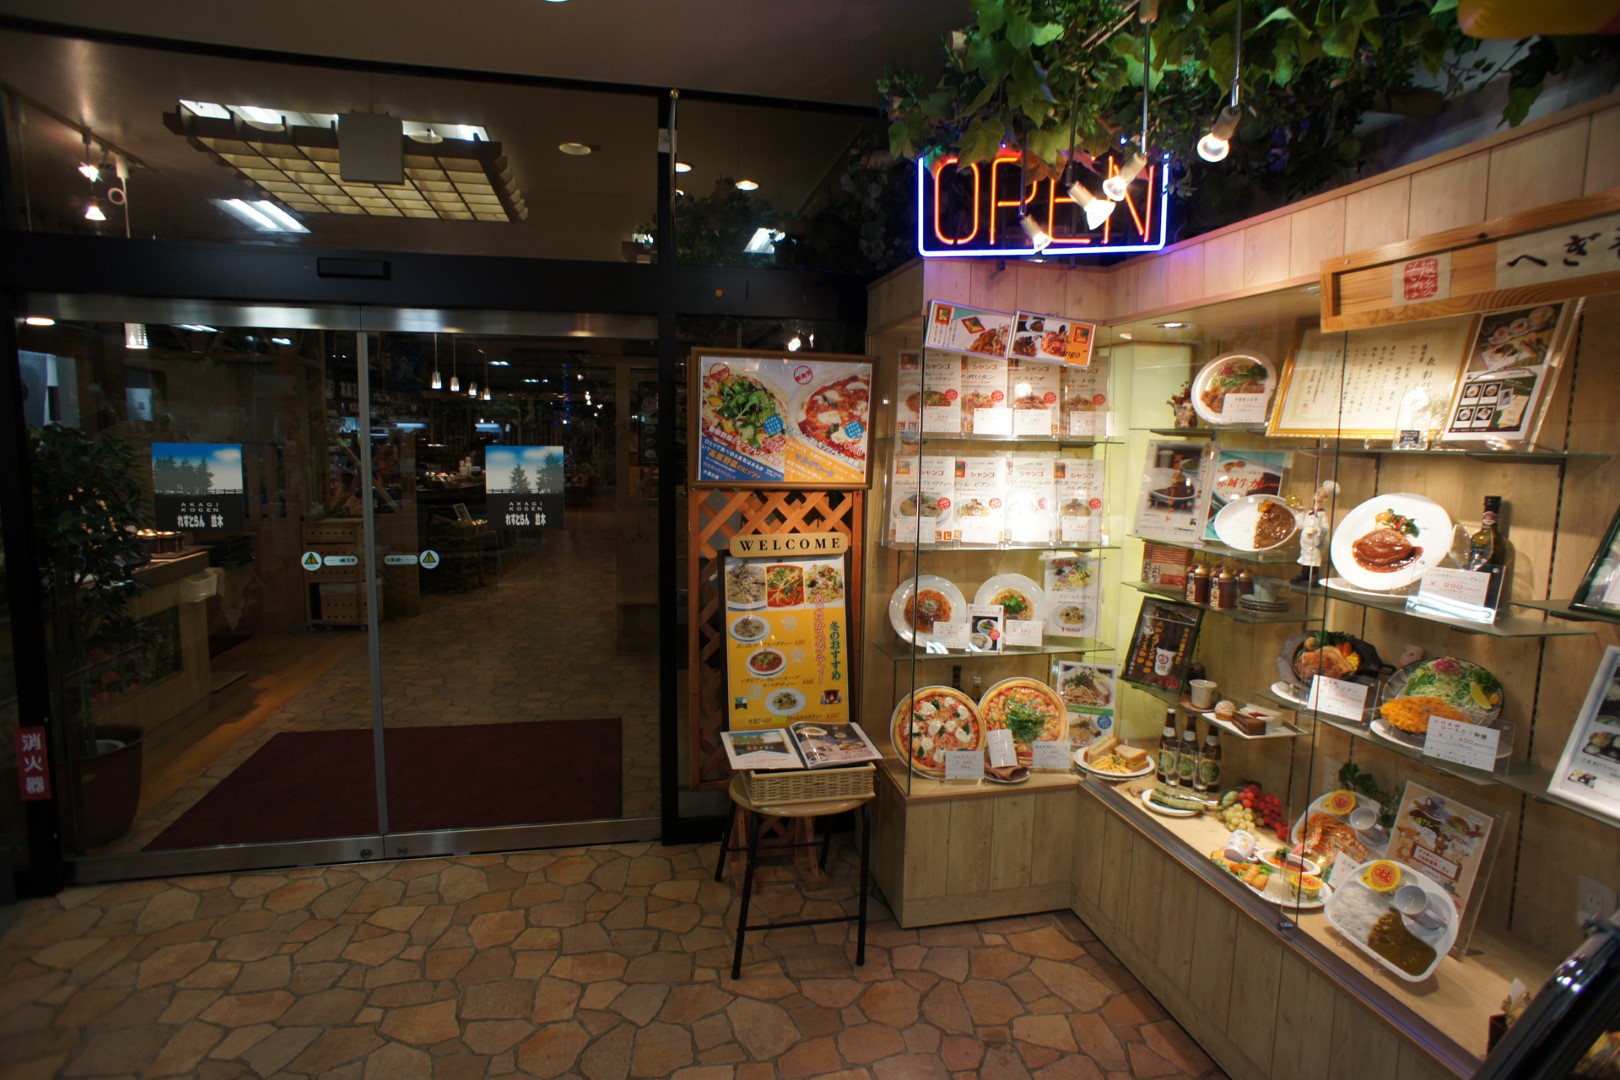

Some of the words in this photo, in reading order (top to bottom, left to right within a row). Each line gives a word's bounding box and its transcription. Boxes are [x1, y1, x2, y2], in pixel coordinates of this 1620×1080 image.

[934, 156, 1154, 245] OPEN
[177, 515, 205, 527] れすとらん
[505, 513, 530, 526] れすとらん
[739, 538, 840, 551] WELCOME
[829, 621, 841, 680] 冬のおすすめ
[21, 733, 45, 794] 消火器
